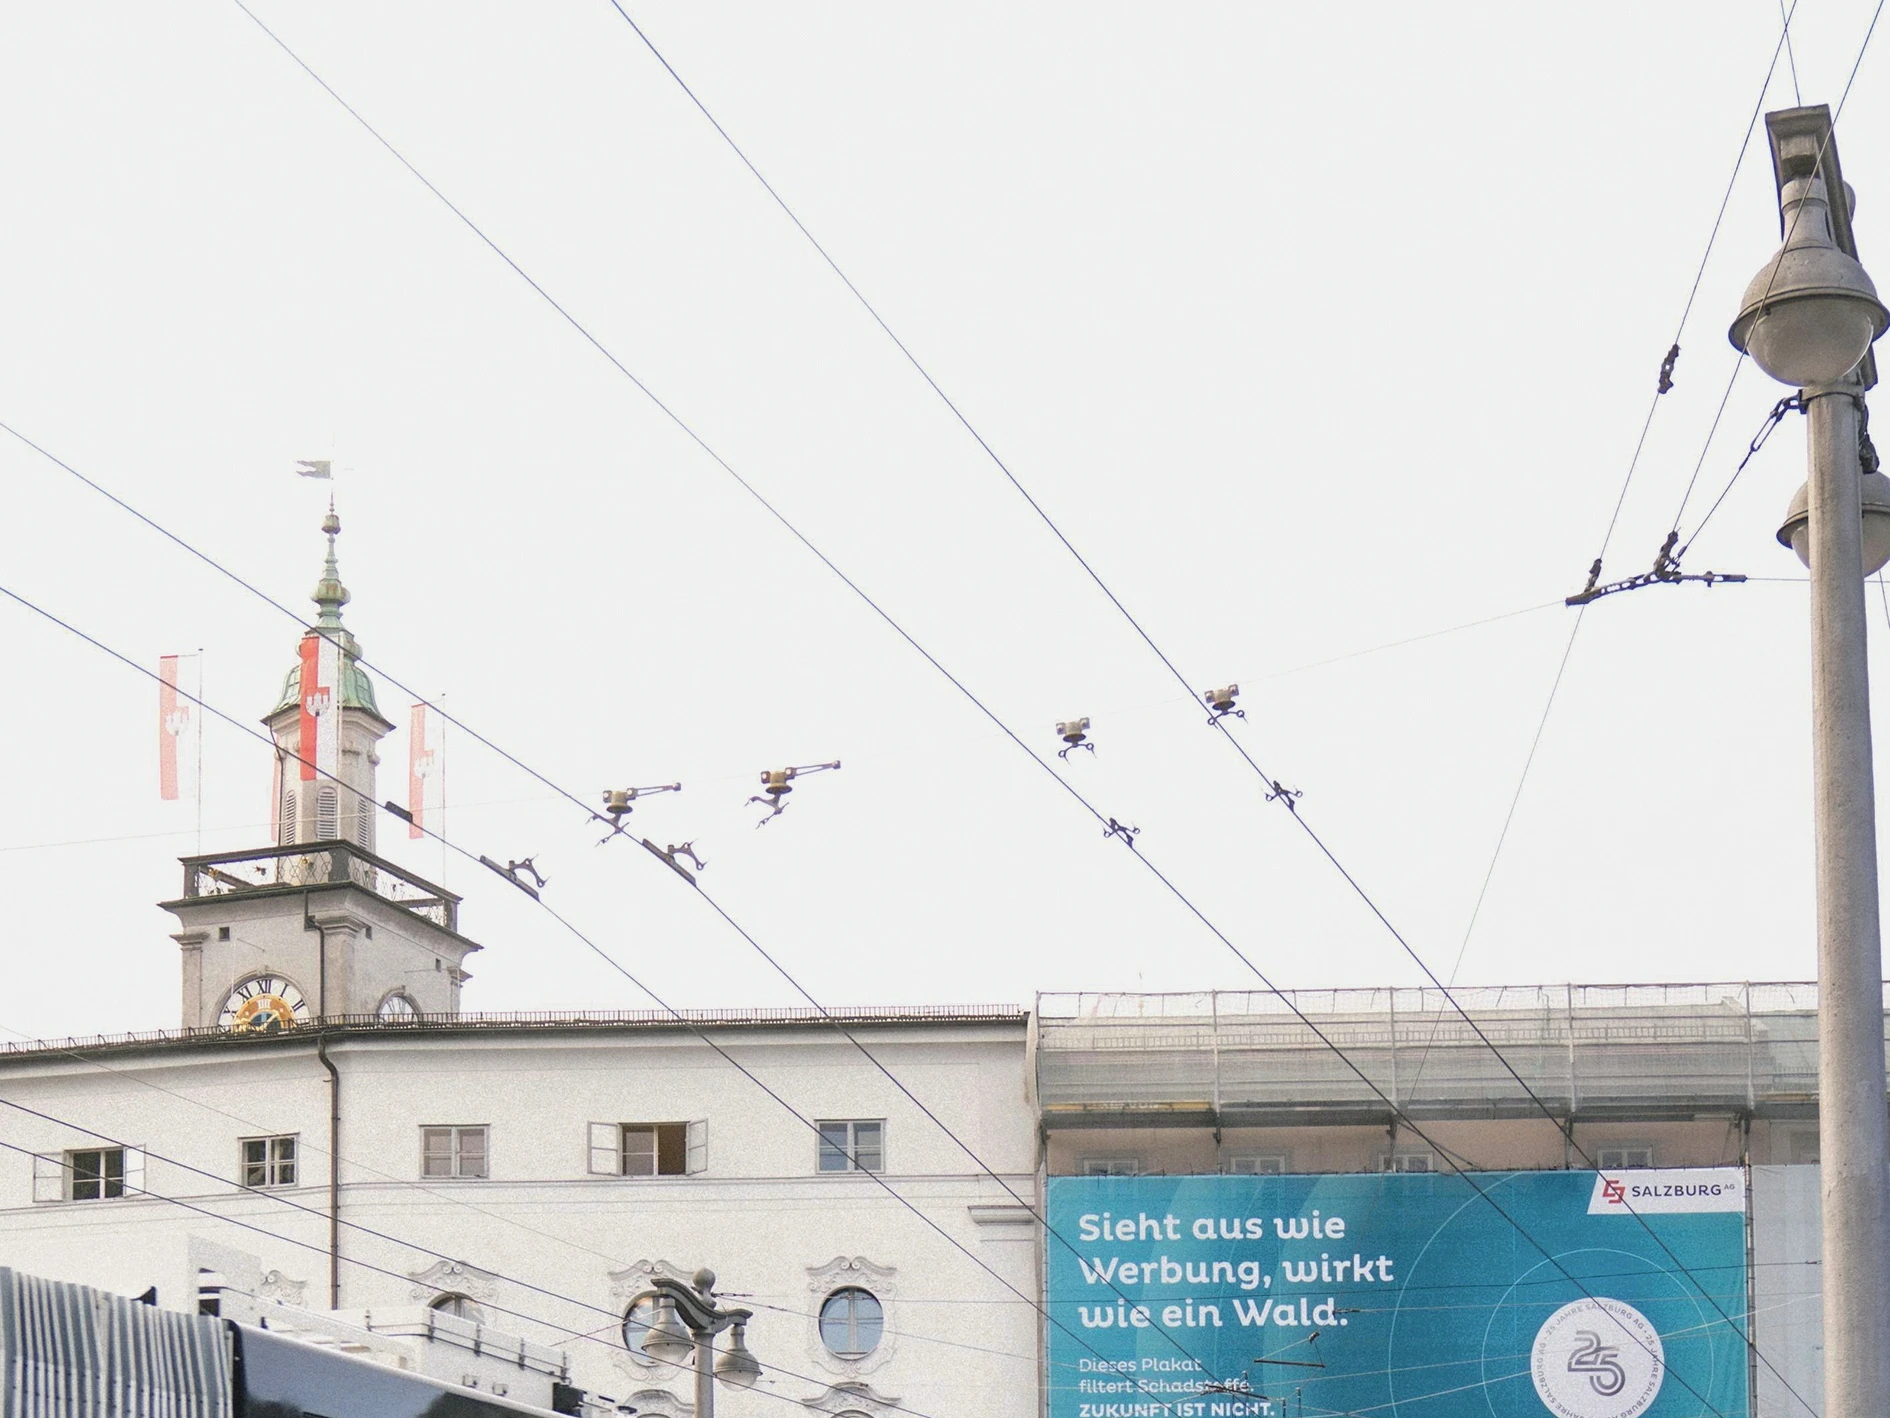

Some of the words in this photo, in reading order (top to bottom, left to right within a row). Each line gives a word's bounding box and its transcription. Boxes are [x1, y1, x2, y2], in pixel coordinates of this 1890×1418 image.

[256, 979, 272, 995] XII
[1632, 1184, 1722, 1198] SALZBURG
[1078, 1212, 1181, 1241] Sieht
[1191, 1216, 1263, 1240] aus
[1273, 1209, 1346, 1240] wie
[1077, 1255, 1272, 1290] Werbung,
[1282, 1252, 1395, 1283] wirkt
[1077, 1298, 1150, 1328] wie
[1161, 1297, 1223, 1327] ein
[1232, 1297, 1348, 1327] Wald.
[1556, 1304, 1583, 1326] JAHRE
[1585, 1303, 1632, 1320] SALZBURG
[1633, 1318, 1645, 1330] AG
[1079, 1358, 1137, 1372] Dieses
[1141, 1357, 1202, 1372] Plakat
[1650, 1348, 1659, 1380] JAHRE
[1079, 1380, 1133, 1394] filtert
[1537, 1358, 1557, 1404] SALZBURG
[1079, 1403, 1171, 1418] ZUKUNFT
[1177, 1402, 1205, 1417] IST
[1210, 1402, 1275, 1417] NICHT.
[1629, 1382, 1656, 1415] SALZBURG
